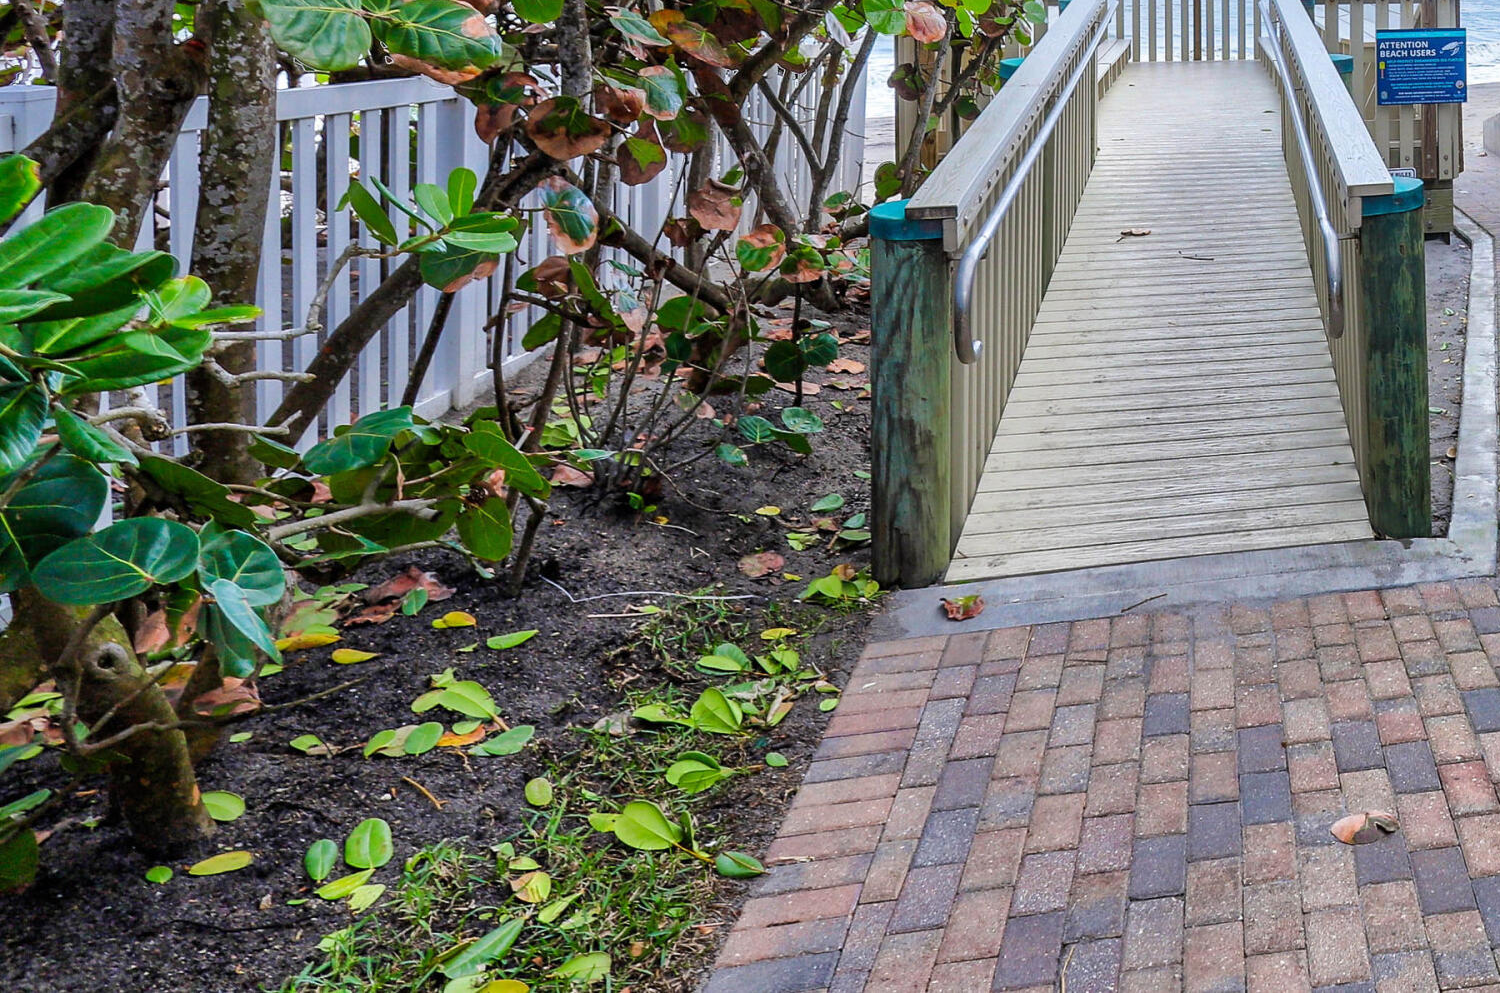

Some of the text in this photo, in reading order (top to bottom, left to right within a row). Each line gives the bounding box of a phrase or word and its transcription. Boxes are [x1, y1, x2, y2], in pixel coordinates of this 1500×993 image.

[1379, 41, 1429, 49] ATTENTION
[1379, 49, 1437, 58] BEACH USERS
